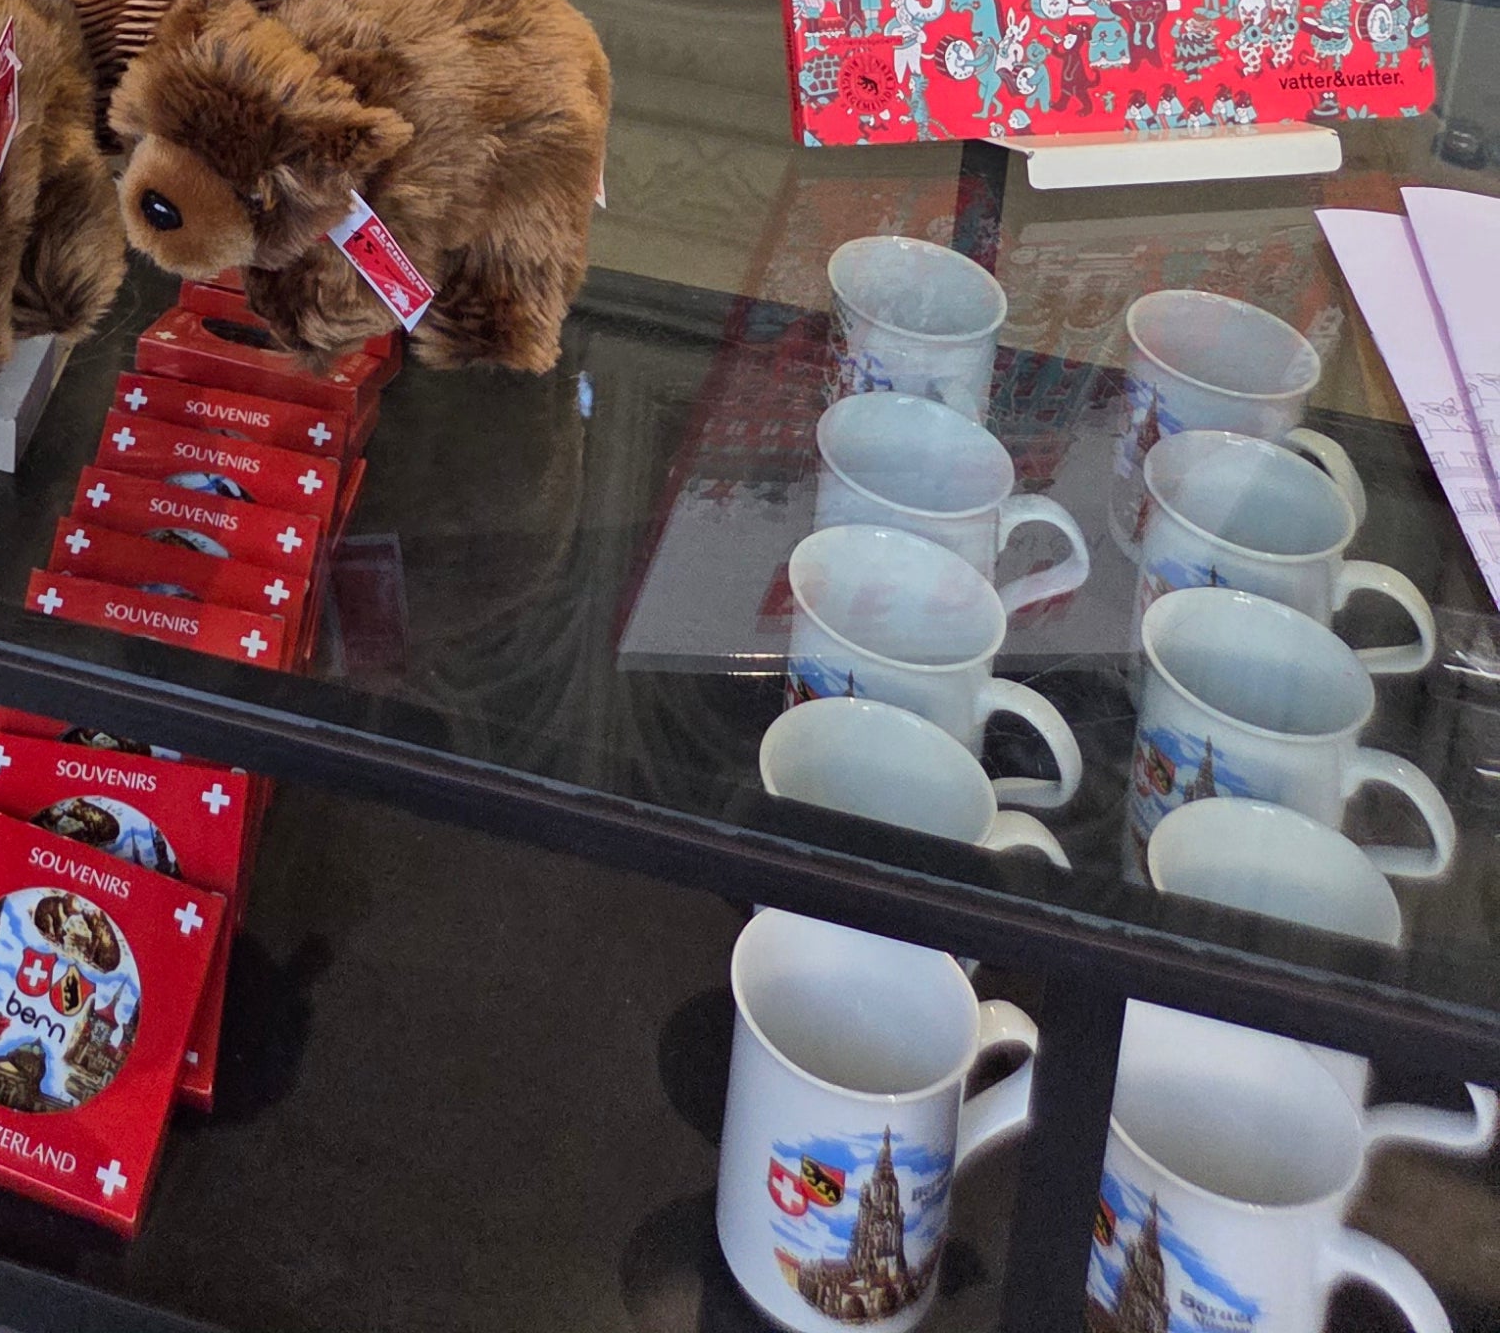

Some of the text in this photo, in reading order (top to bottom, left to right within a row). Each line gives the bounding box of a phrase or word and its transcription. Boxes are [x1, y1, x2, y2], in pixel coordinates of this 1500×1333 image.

[368, 225, 426, 292] ALPHORN
[185, 399, 271, 428] SOUVENIRS
[173, 441, 261, 474] SOUVENIRS
[149, 496, 239, 531] SOUVENIRS
[104, 601, 199, 635] SOUVENIRS
[55, 759, 157, 793] SOUVENIRS
[28, 846, 131, 899] SOUVENIRS
[6, 996, 67, 1044] bern
